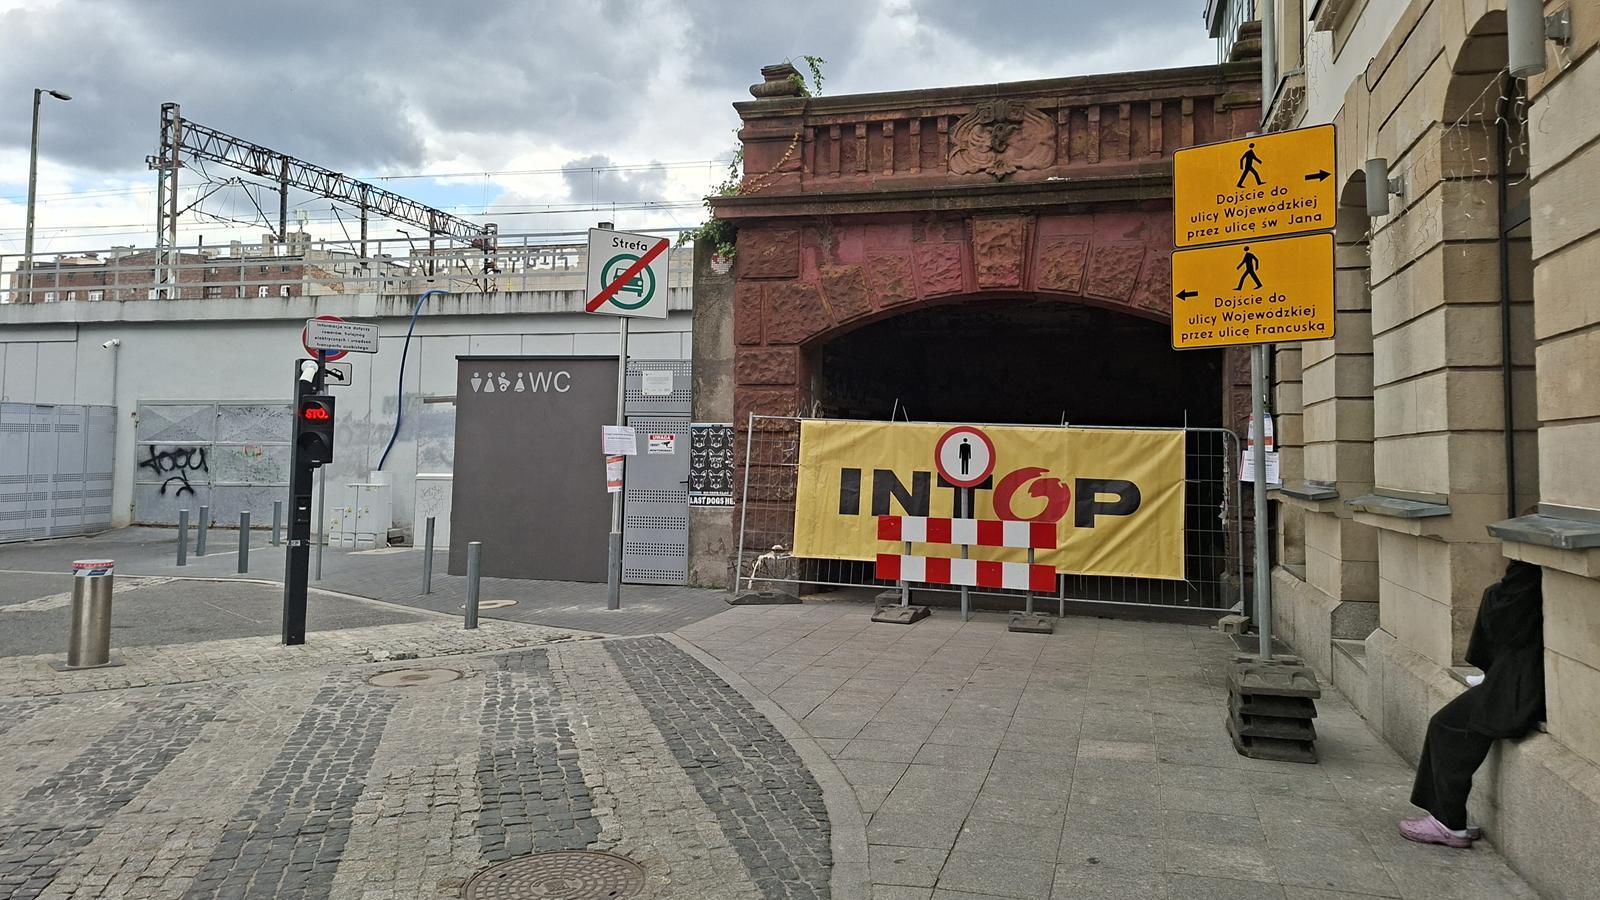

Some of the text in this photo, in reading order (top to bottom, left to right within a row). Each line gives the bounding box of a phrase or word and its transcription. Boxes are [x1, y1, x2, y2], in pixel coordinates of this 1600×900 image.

[1217, 186, 1288, 205] Dojście do
[1190, 195, 1318, 224] ulicy Wojewódzkiej
[1187, 226, 1219, 242] przez
[1225, 220, 1256, 233] ulicę
[1288, 213, 1322, 225] Jana
[612, 237, 648, 251] Strefa
[1214, 292, 1286, 309] Dojście do
[1188, 305, 1316, 326] ulicy Wojewódzkiej
[1181, 321, 1325, 343] przez ulicę Francuską
[529, 371, 571, 393] WC
[690, 496, 706, 505] LAST
[706, 496, 725, 505] DOGS
